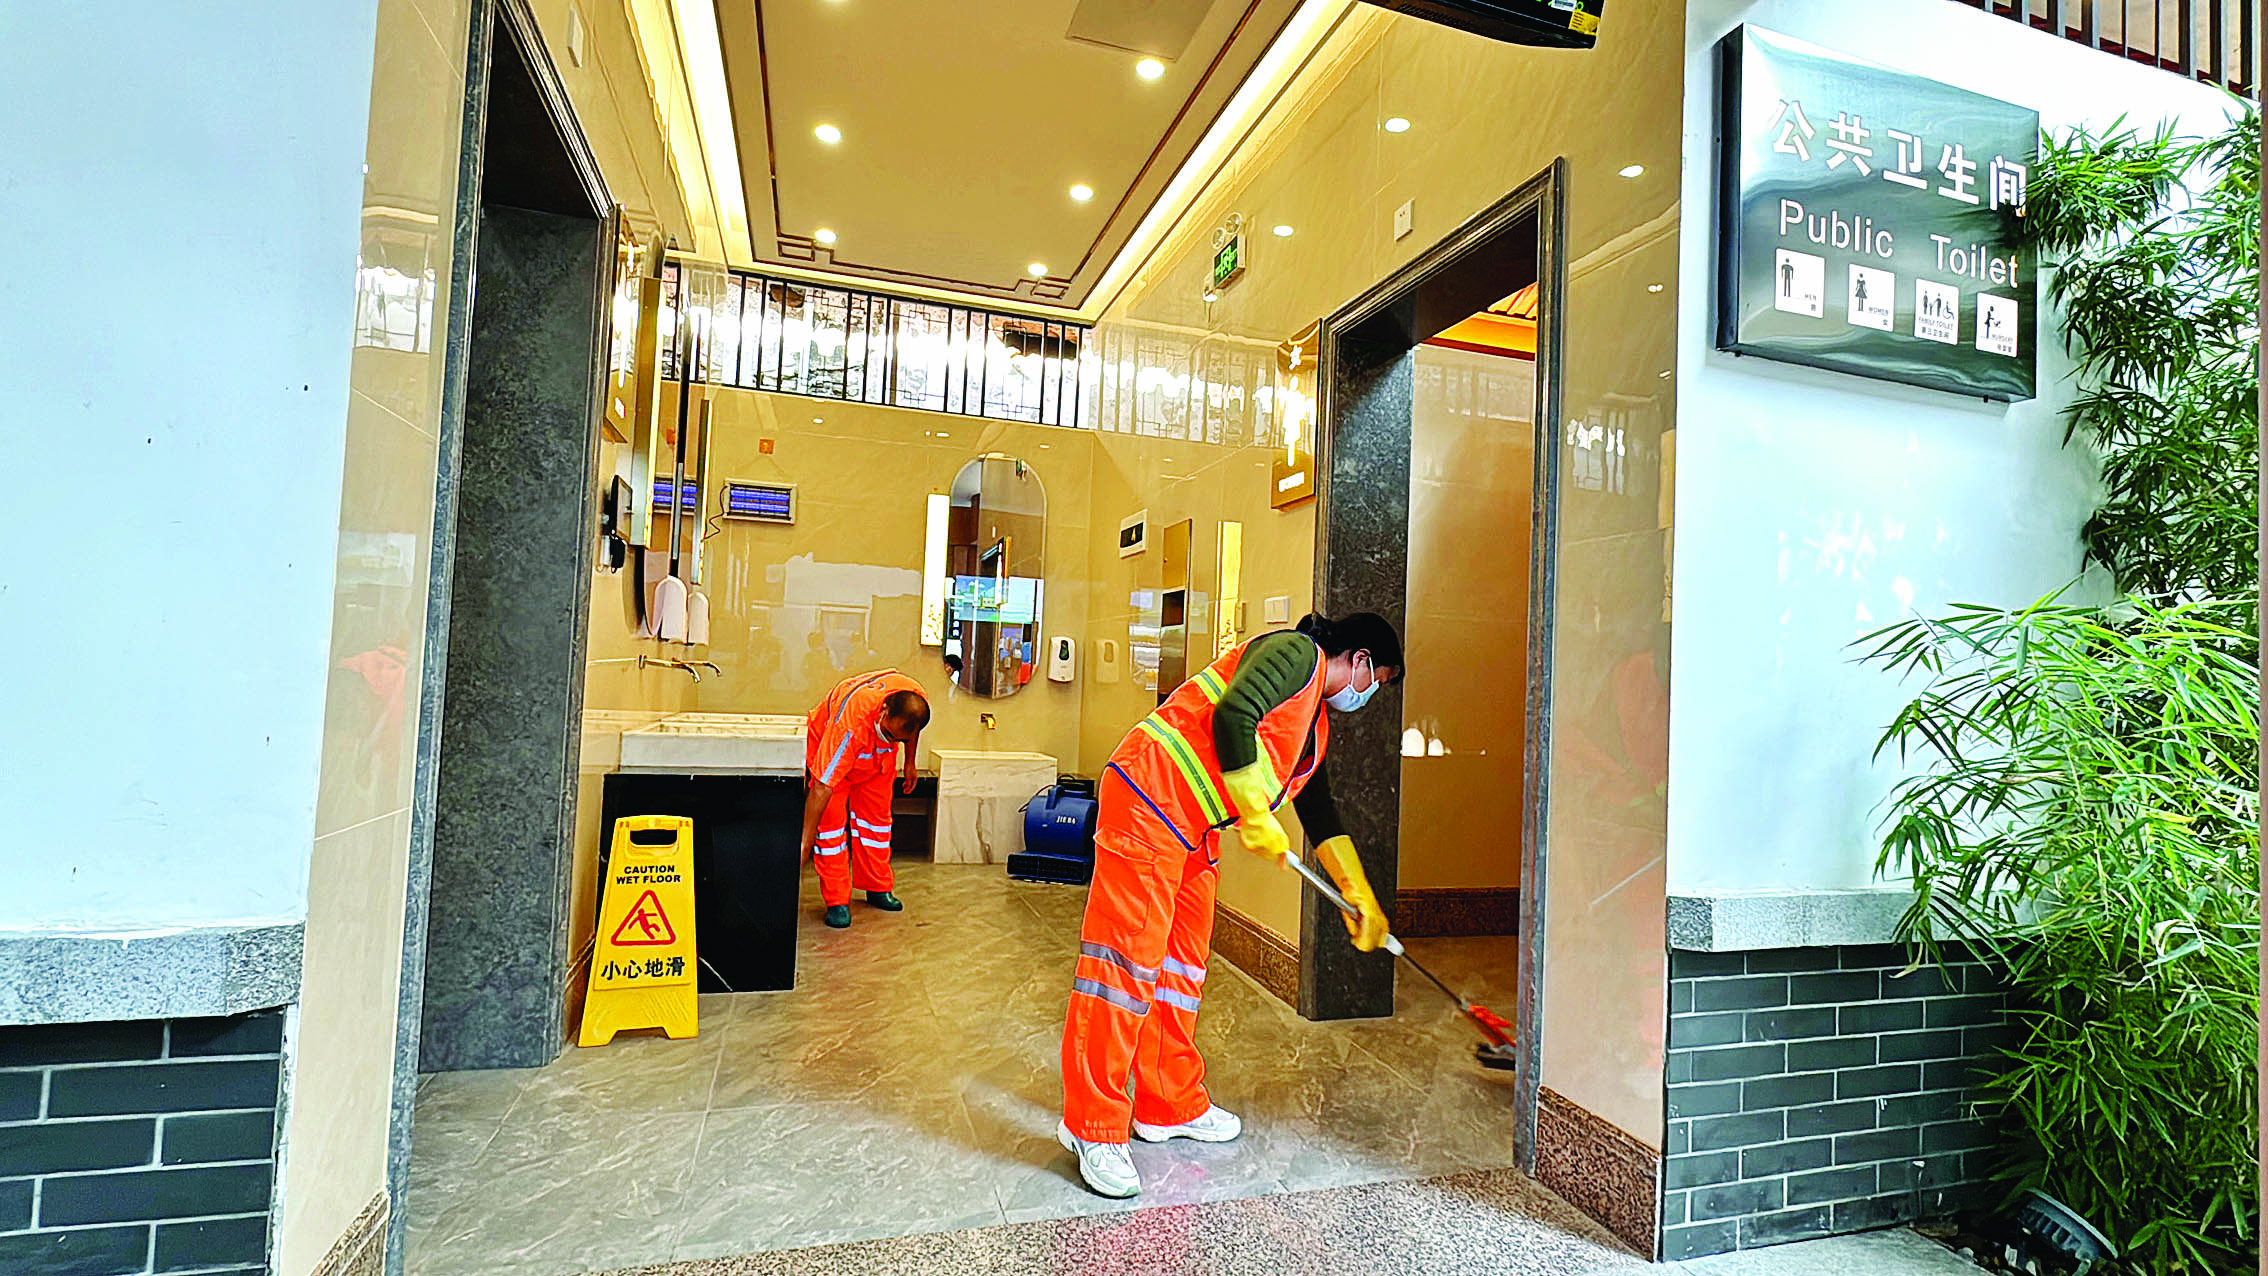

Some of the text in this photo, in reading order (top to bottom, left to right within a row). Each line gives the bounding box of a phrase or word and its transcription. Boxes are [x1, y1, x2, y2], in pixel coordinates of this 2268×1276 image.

[1768, 99, 2027, 217] 公共卫生间
[1779, 198, 2019, 289] Public Toilet
[616, 874, 681, 885] WET FLOOR
[624, 865, 675, 874] CAUTION
[601, 956, 685, 981] 小心地滑
